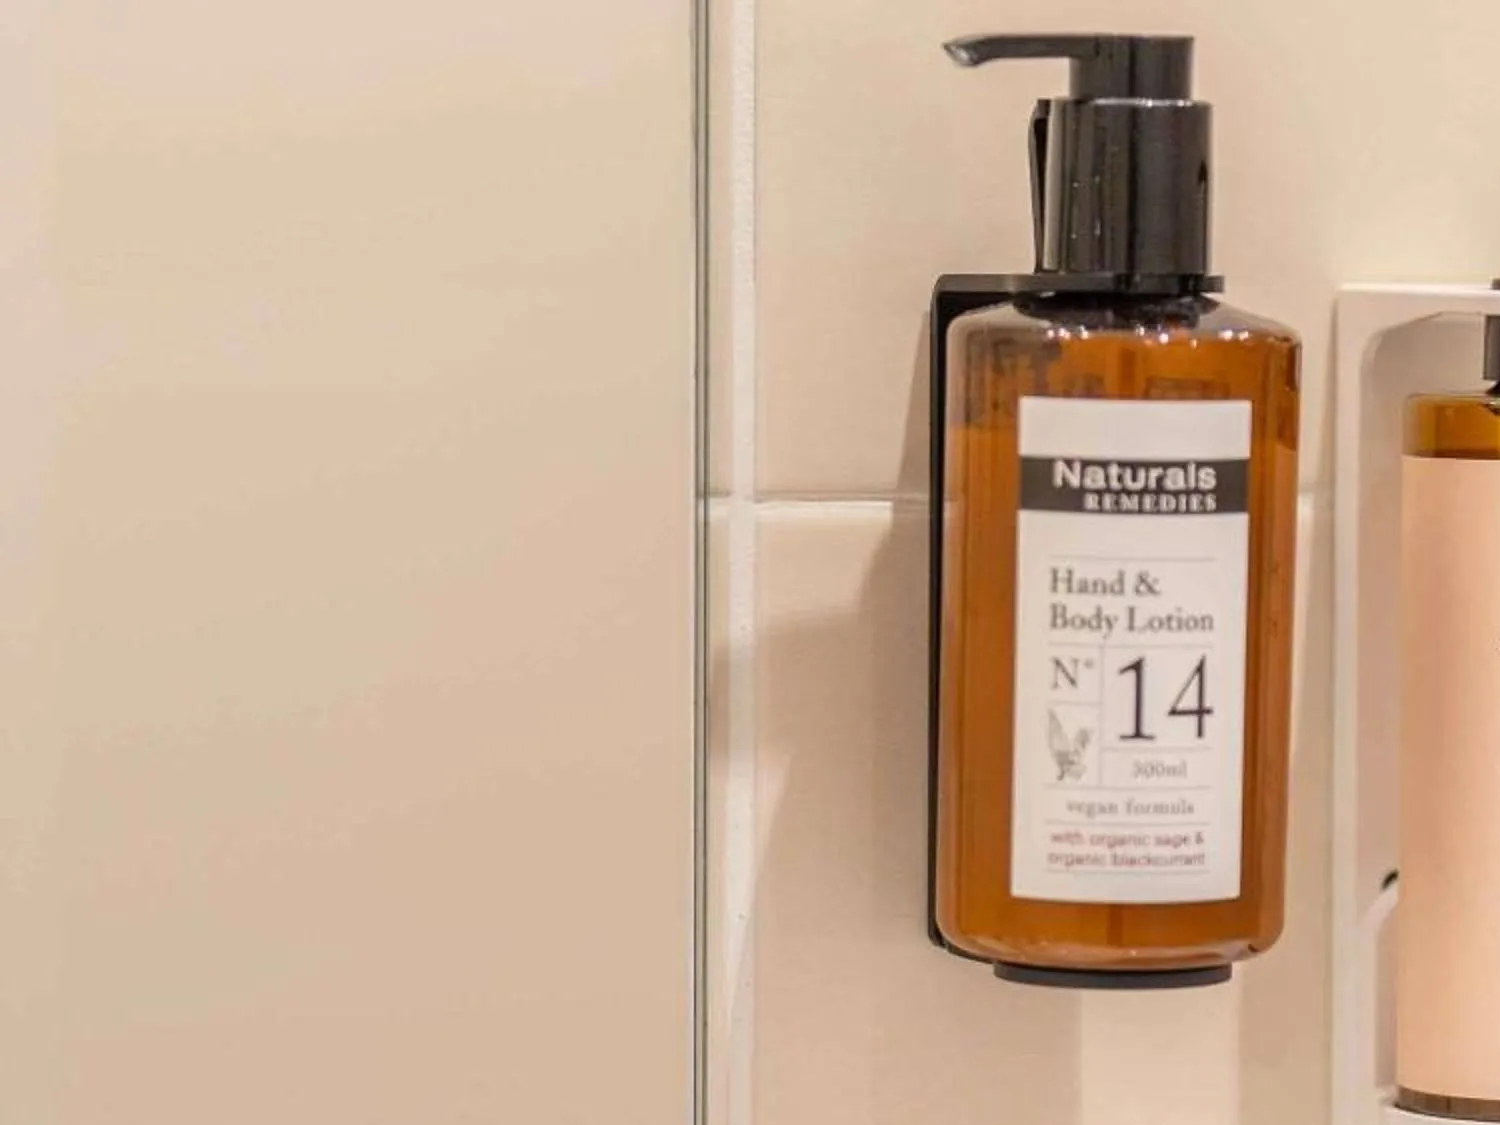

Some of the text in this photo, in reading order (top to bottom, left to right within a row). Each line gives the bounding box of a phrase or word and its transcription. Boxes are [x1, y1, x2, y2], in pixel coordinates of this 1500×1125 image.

[1053, 459, 1217, 490] Naturals
[1083, 492, 1217, 511] REMEDIES
[1050, 567, 1162, 596] Hand &
[1050, 603, 1214, 640] Body Lotion
[1117, 655, 1214, 740] 14
[1132, 760, 1187, 778] 300ml
[1066, 798, 1195, 818] vegan formula
[1089, 833, 1149, 849] organic
